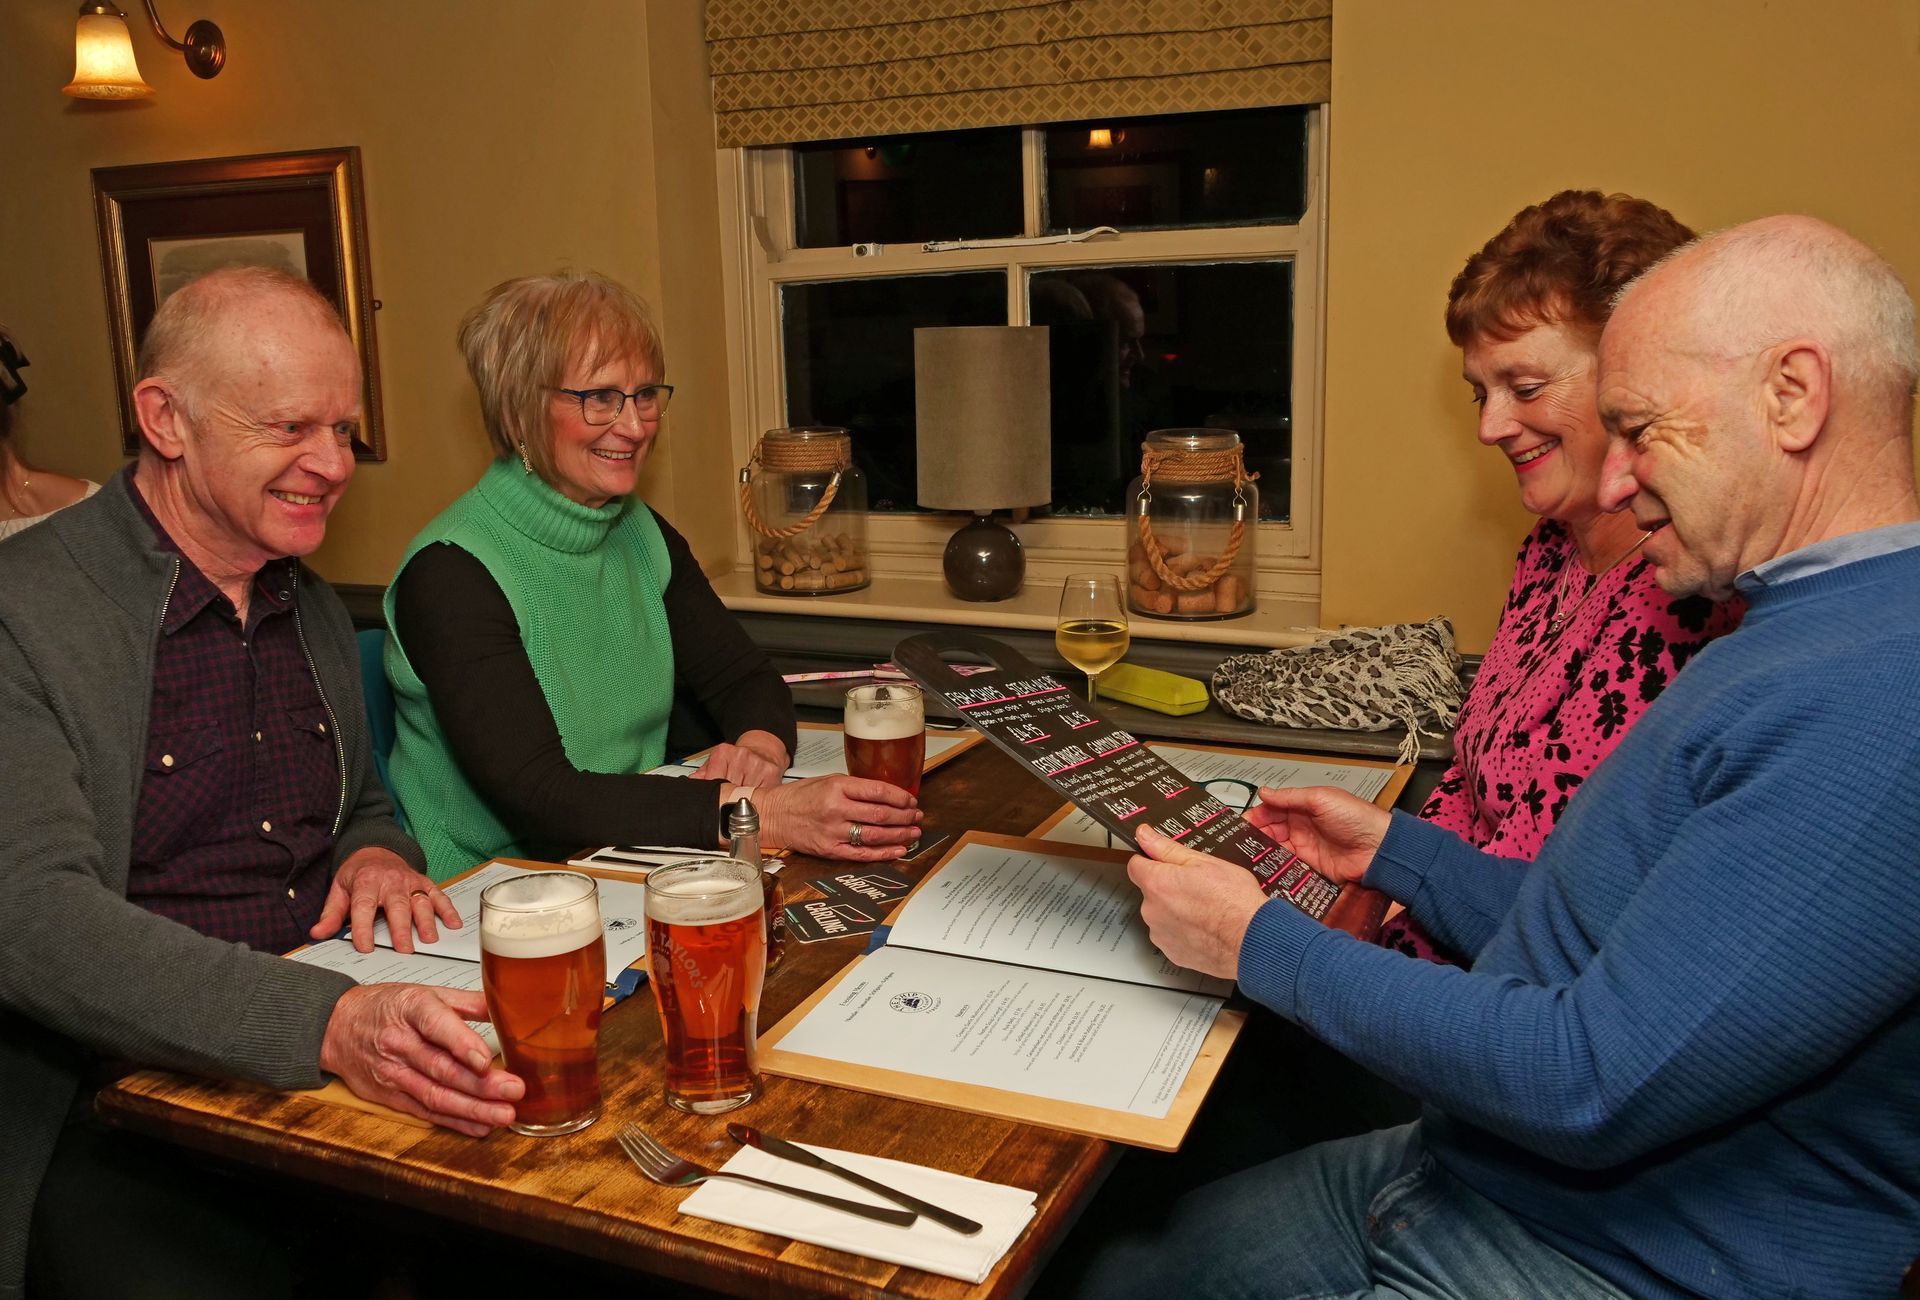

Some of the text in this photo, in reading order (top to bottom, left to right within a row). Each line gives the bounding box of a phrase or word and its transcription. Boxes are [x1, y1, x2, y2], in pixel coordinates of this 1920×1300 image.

[945, 692, 975, 705] FISH
[970, 686, 1005, 701] CHIPS
[1005, 681, 1038, 696] STEAK
[1031, 679, 1053, 690] ALE
[1087, 731, 1135, 754] GAMMON STEAK
[1032, 745, 1091, 773] FESTIVE BURGER
[1182, 796, 1226, 826] LAMBS LIVER
[1160, 818, 1189, 837] KIEV
[1253, 863, 1274, 877] TRIO
[1264, 857, 1278, 870] OF
[835, 874, 887, 899] CARLING
[804, 902, 848, 933] CARLING
[660, 933, 708, 989] TAYLOR'S
